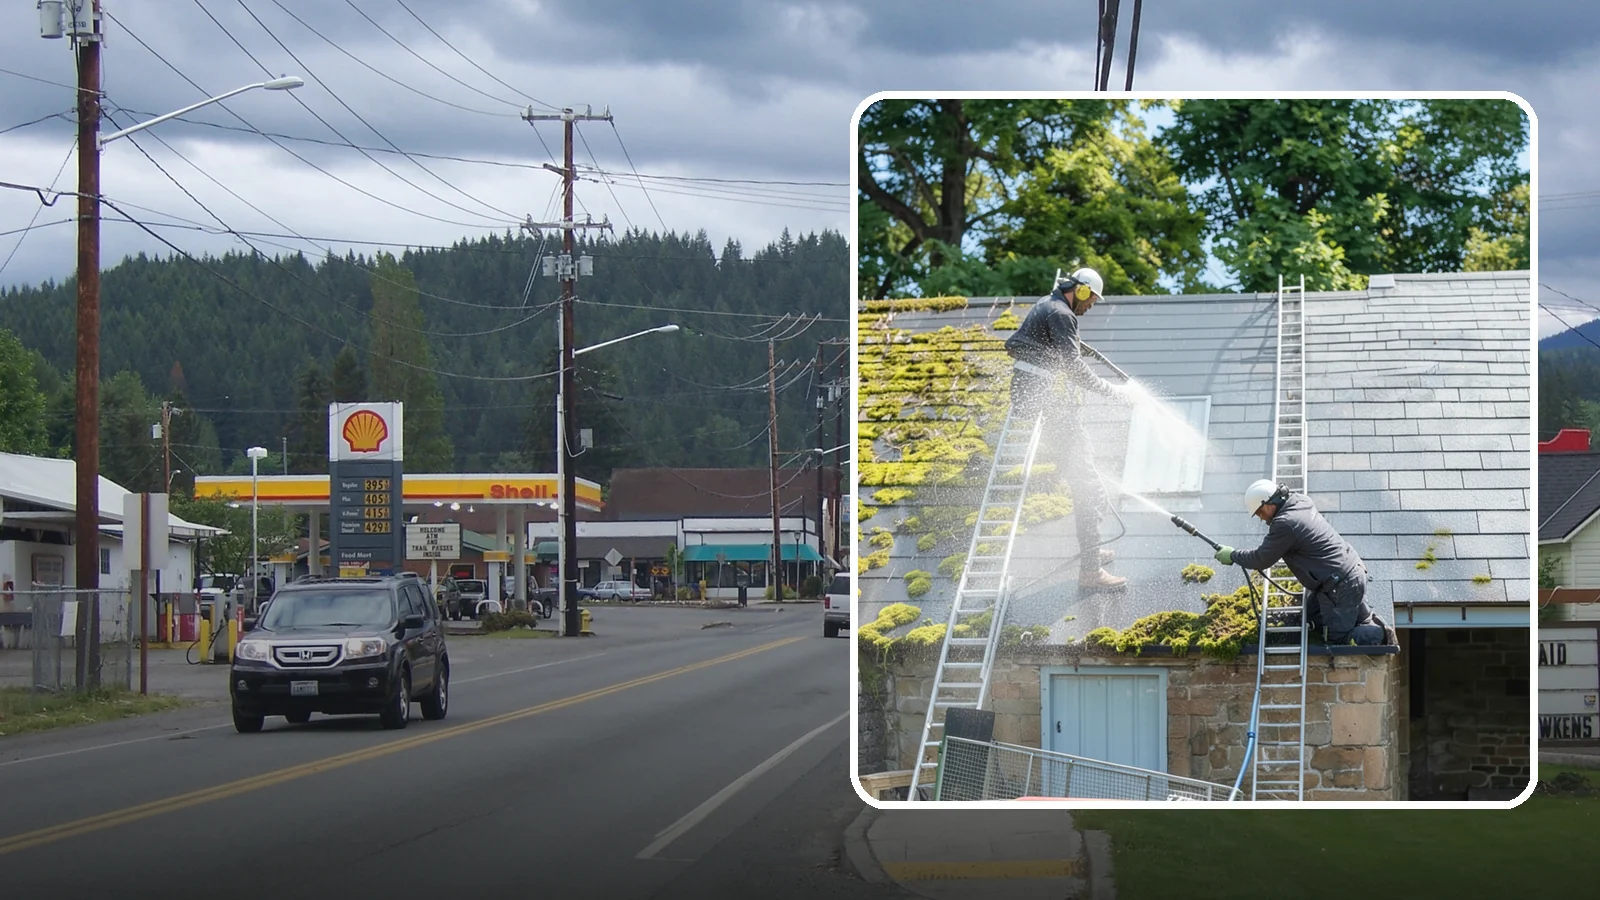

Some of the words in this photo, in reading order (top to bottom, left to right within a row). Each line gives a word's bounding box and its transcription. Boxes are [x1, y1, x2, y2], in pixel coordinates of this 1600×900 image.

[366, 480, 383, 490] 395
[490, 484, 547, 499] Shell
[366, 494, 383, 504] 405
[366, 508, 383, 518] 415
[366, 522, 383, 533] 429
